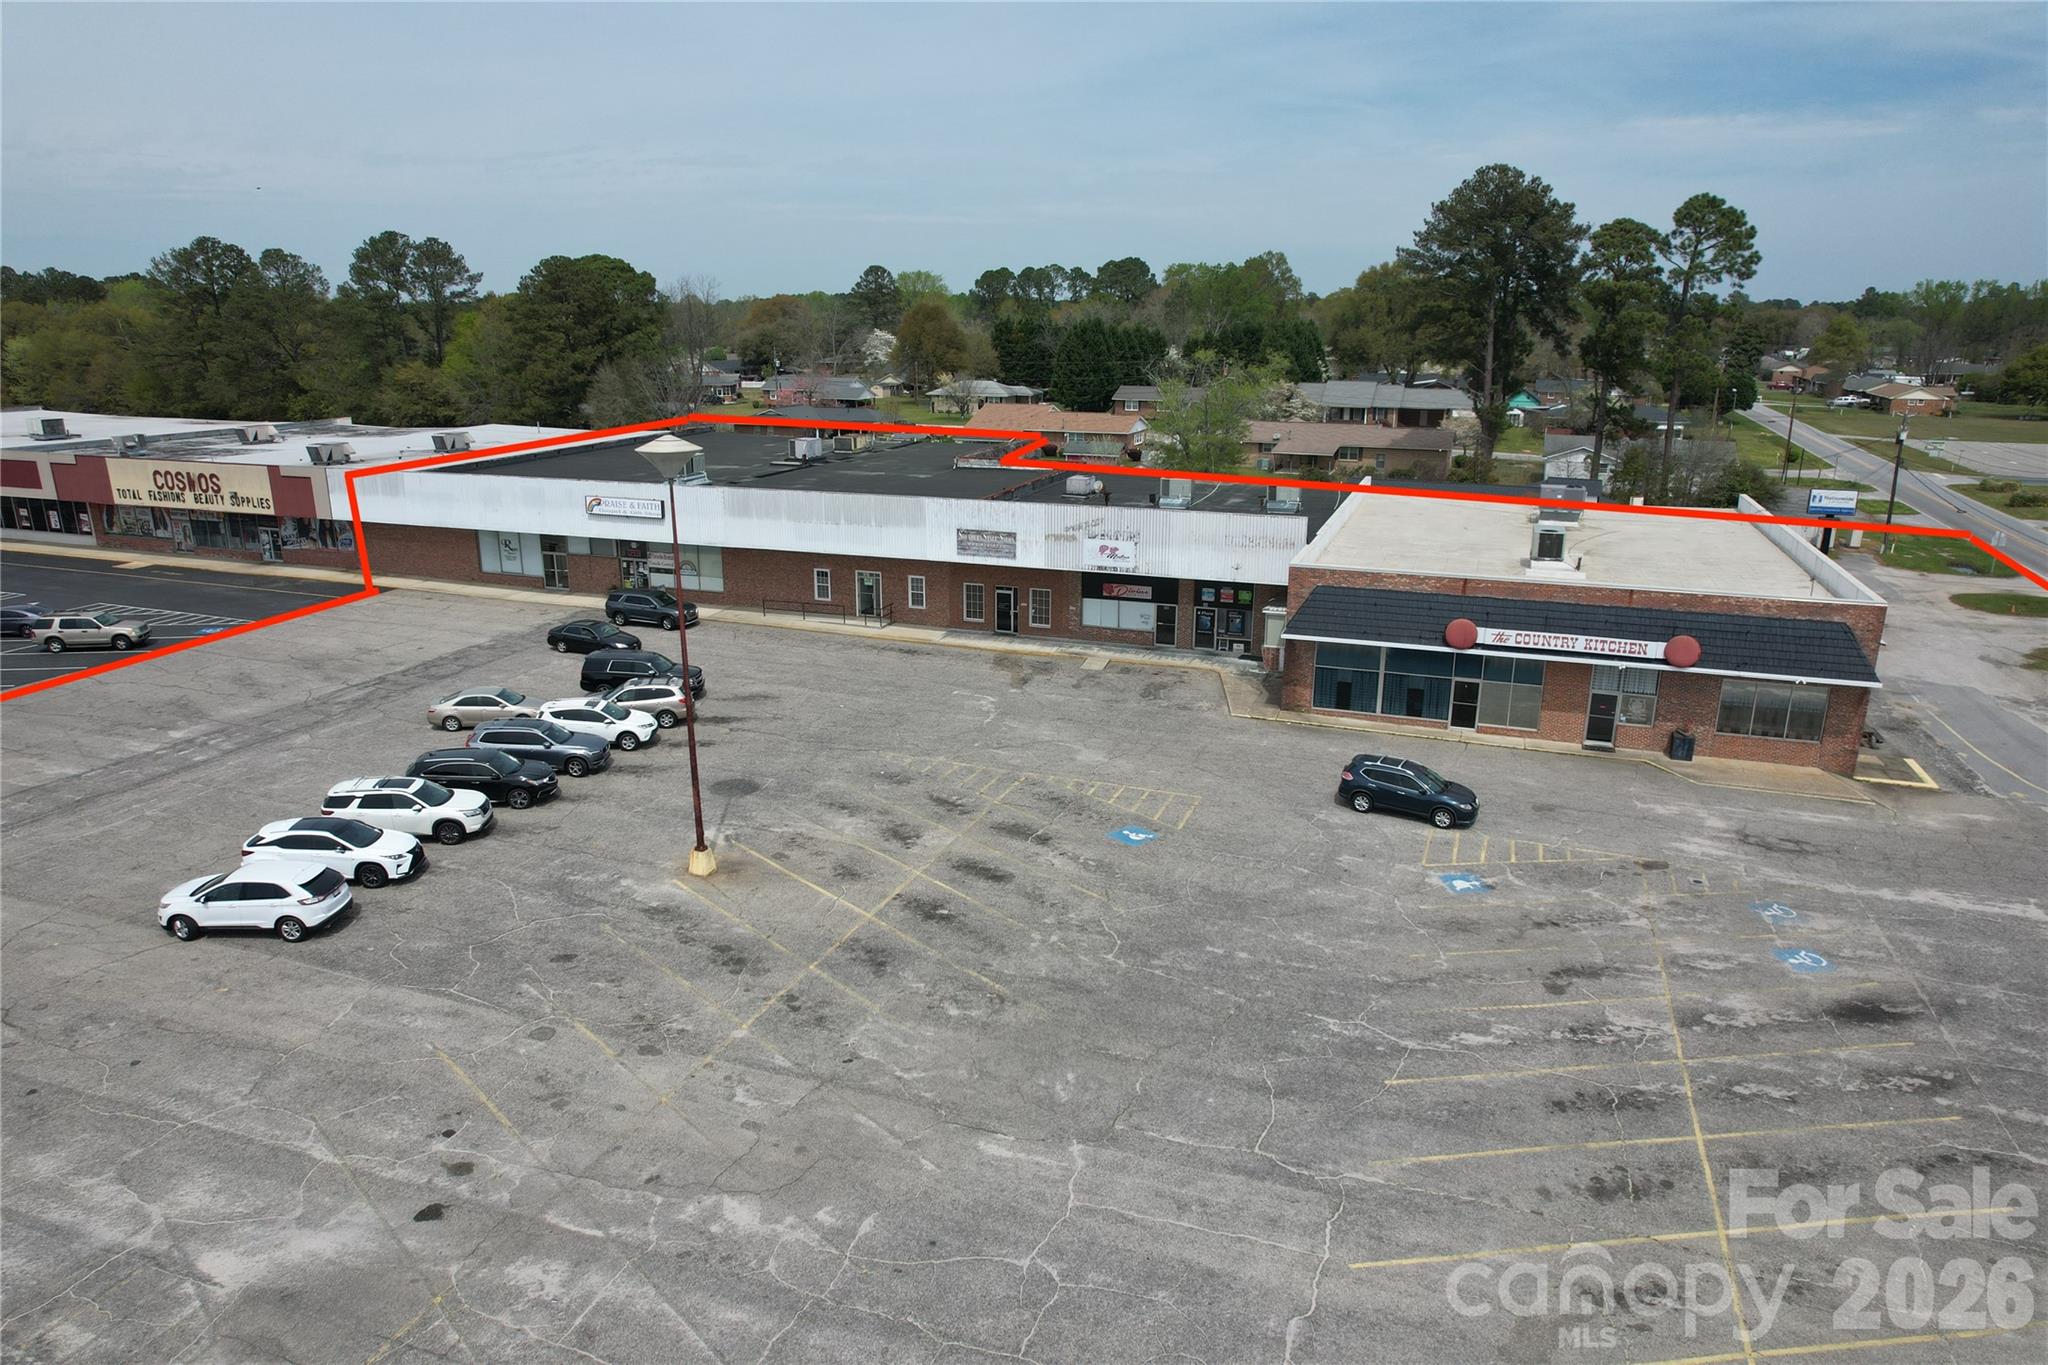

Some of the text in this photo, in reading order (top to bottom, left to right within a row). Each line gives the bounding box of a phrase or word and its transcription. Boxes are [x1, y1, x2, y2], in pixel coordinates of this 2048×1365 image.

[116, 488, 271, 510] TOTAL FASHIONS BEAUTY SUPPLIES
[637, 502, 660, 511] FAITH
[1490, 631, 1649, 656] the COUNTRY KITCHEN
